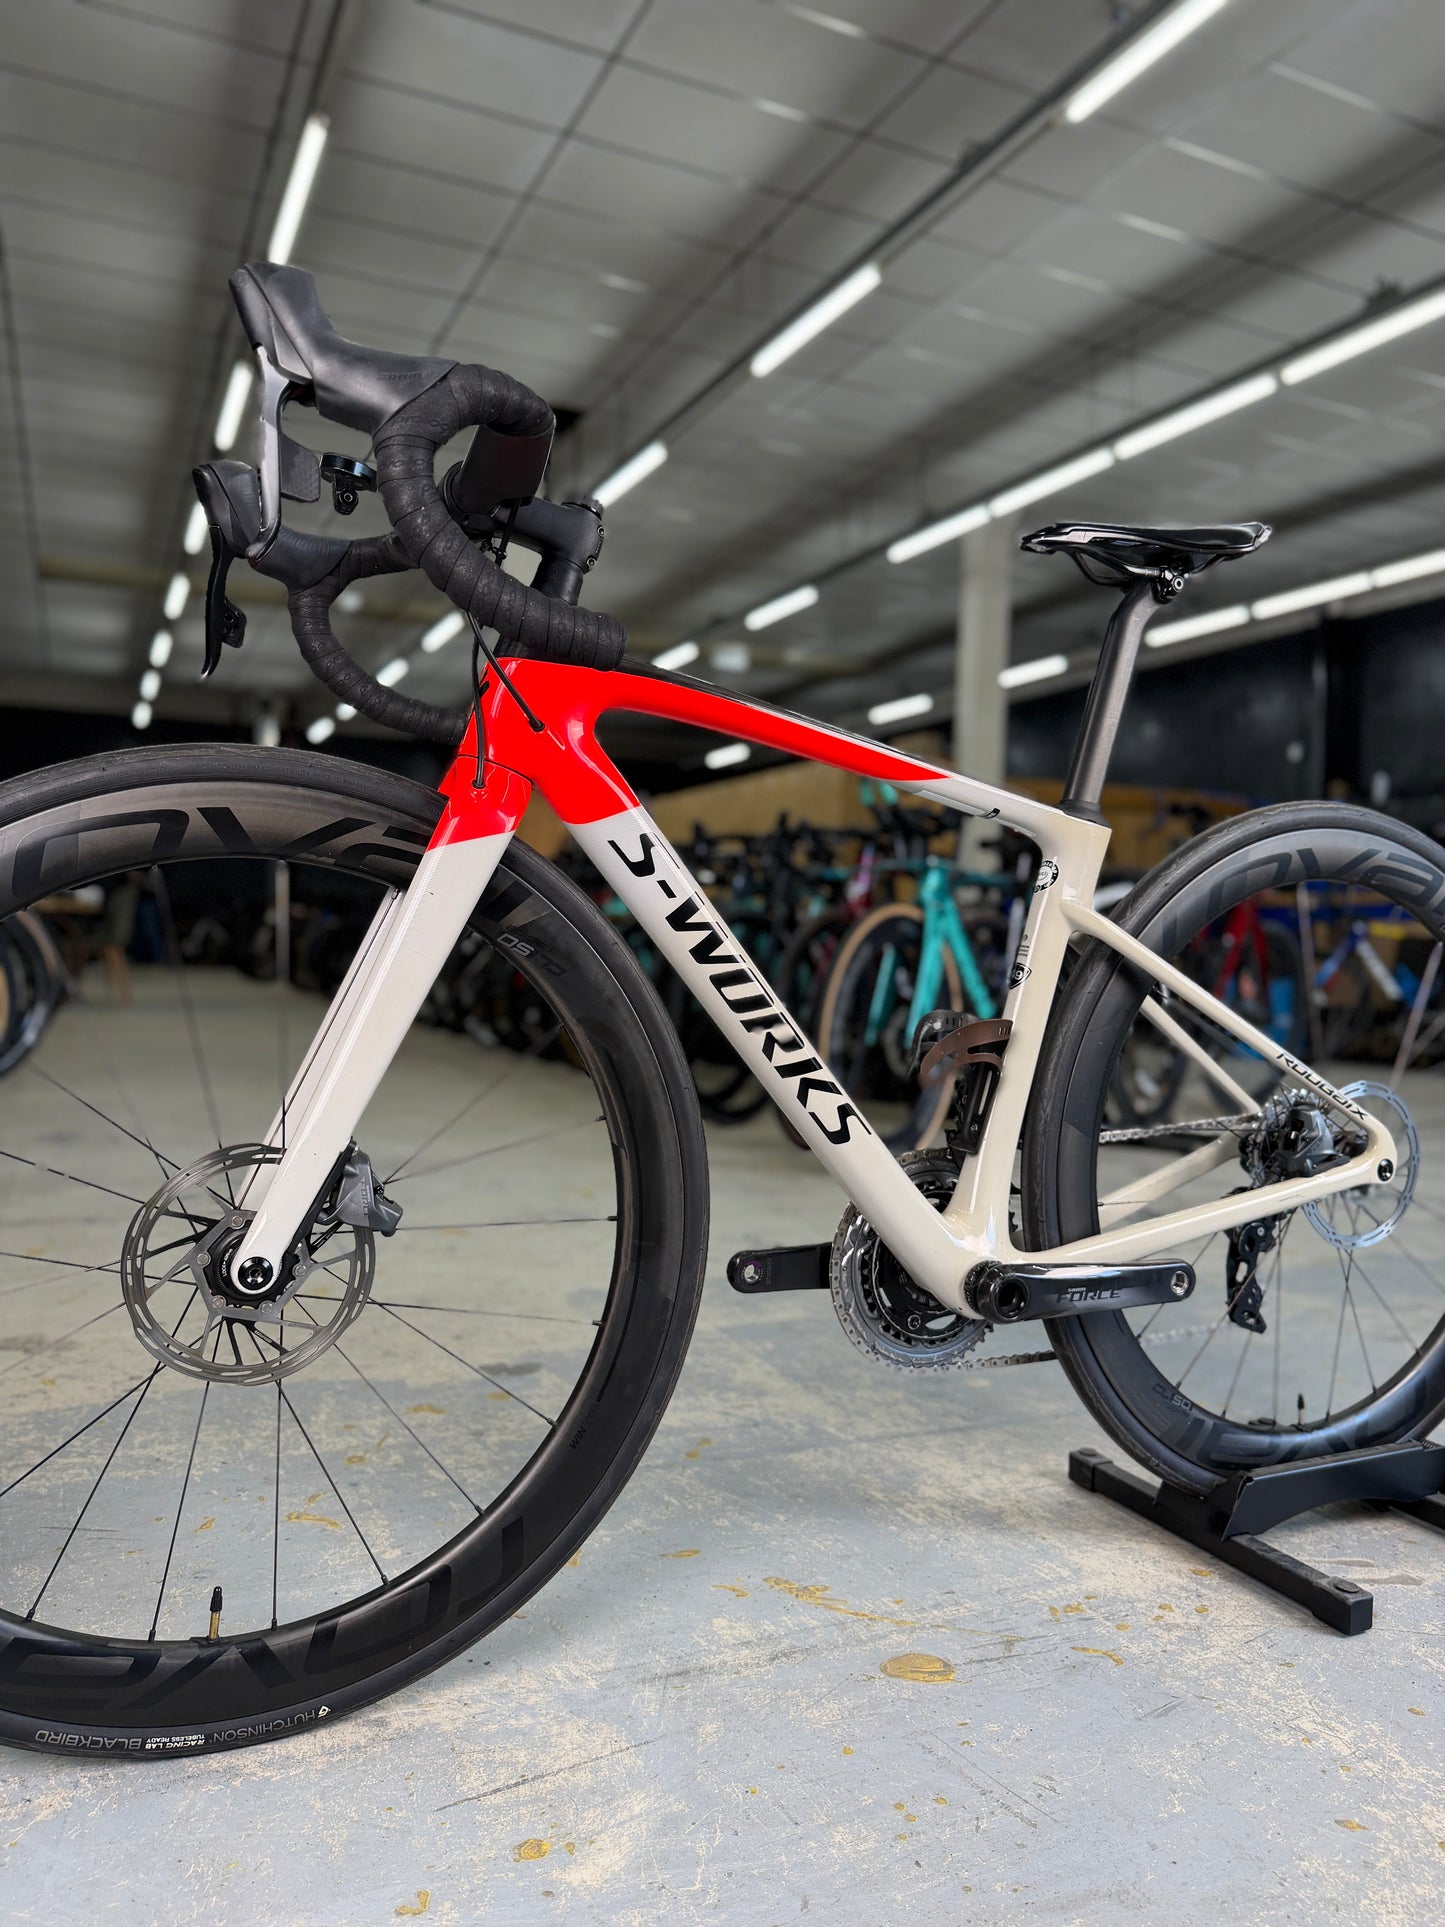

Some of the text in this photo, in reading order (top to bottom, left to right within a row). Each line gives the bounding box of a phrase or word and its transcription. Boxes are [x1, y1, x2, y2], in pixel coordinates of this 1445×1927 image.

[497, 933, 535, 957] 50
[607, 832, 872, 1145] S-WORKS
[1056, 1289, 1121, 1303] FORCE
[212, 1709, 316, 1744] HUTCHINSON
[35, 1729, 142, 1749] BLACKBIRD
[165, 1739, 206, 1749] RACING
[171, 1734, 206, 1743] TUBELESS
